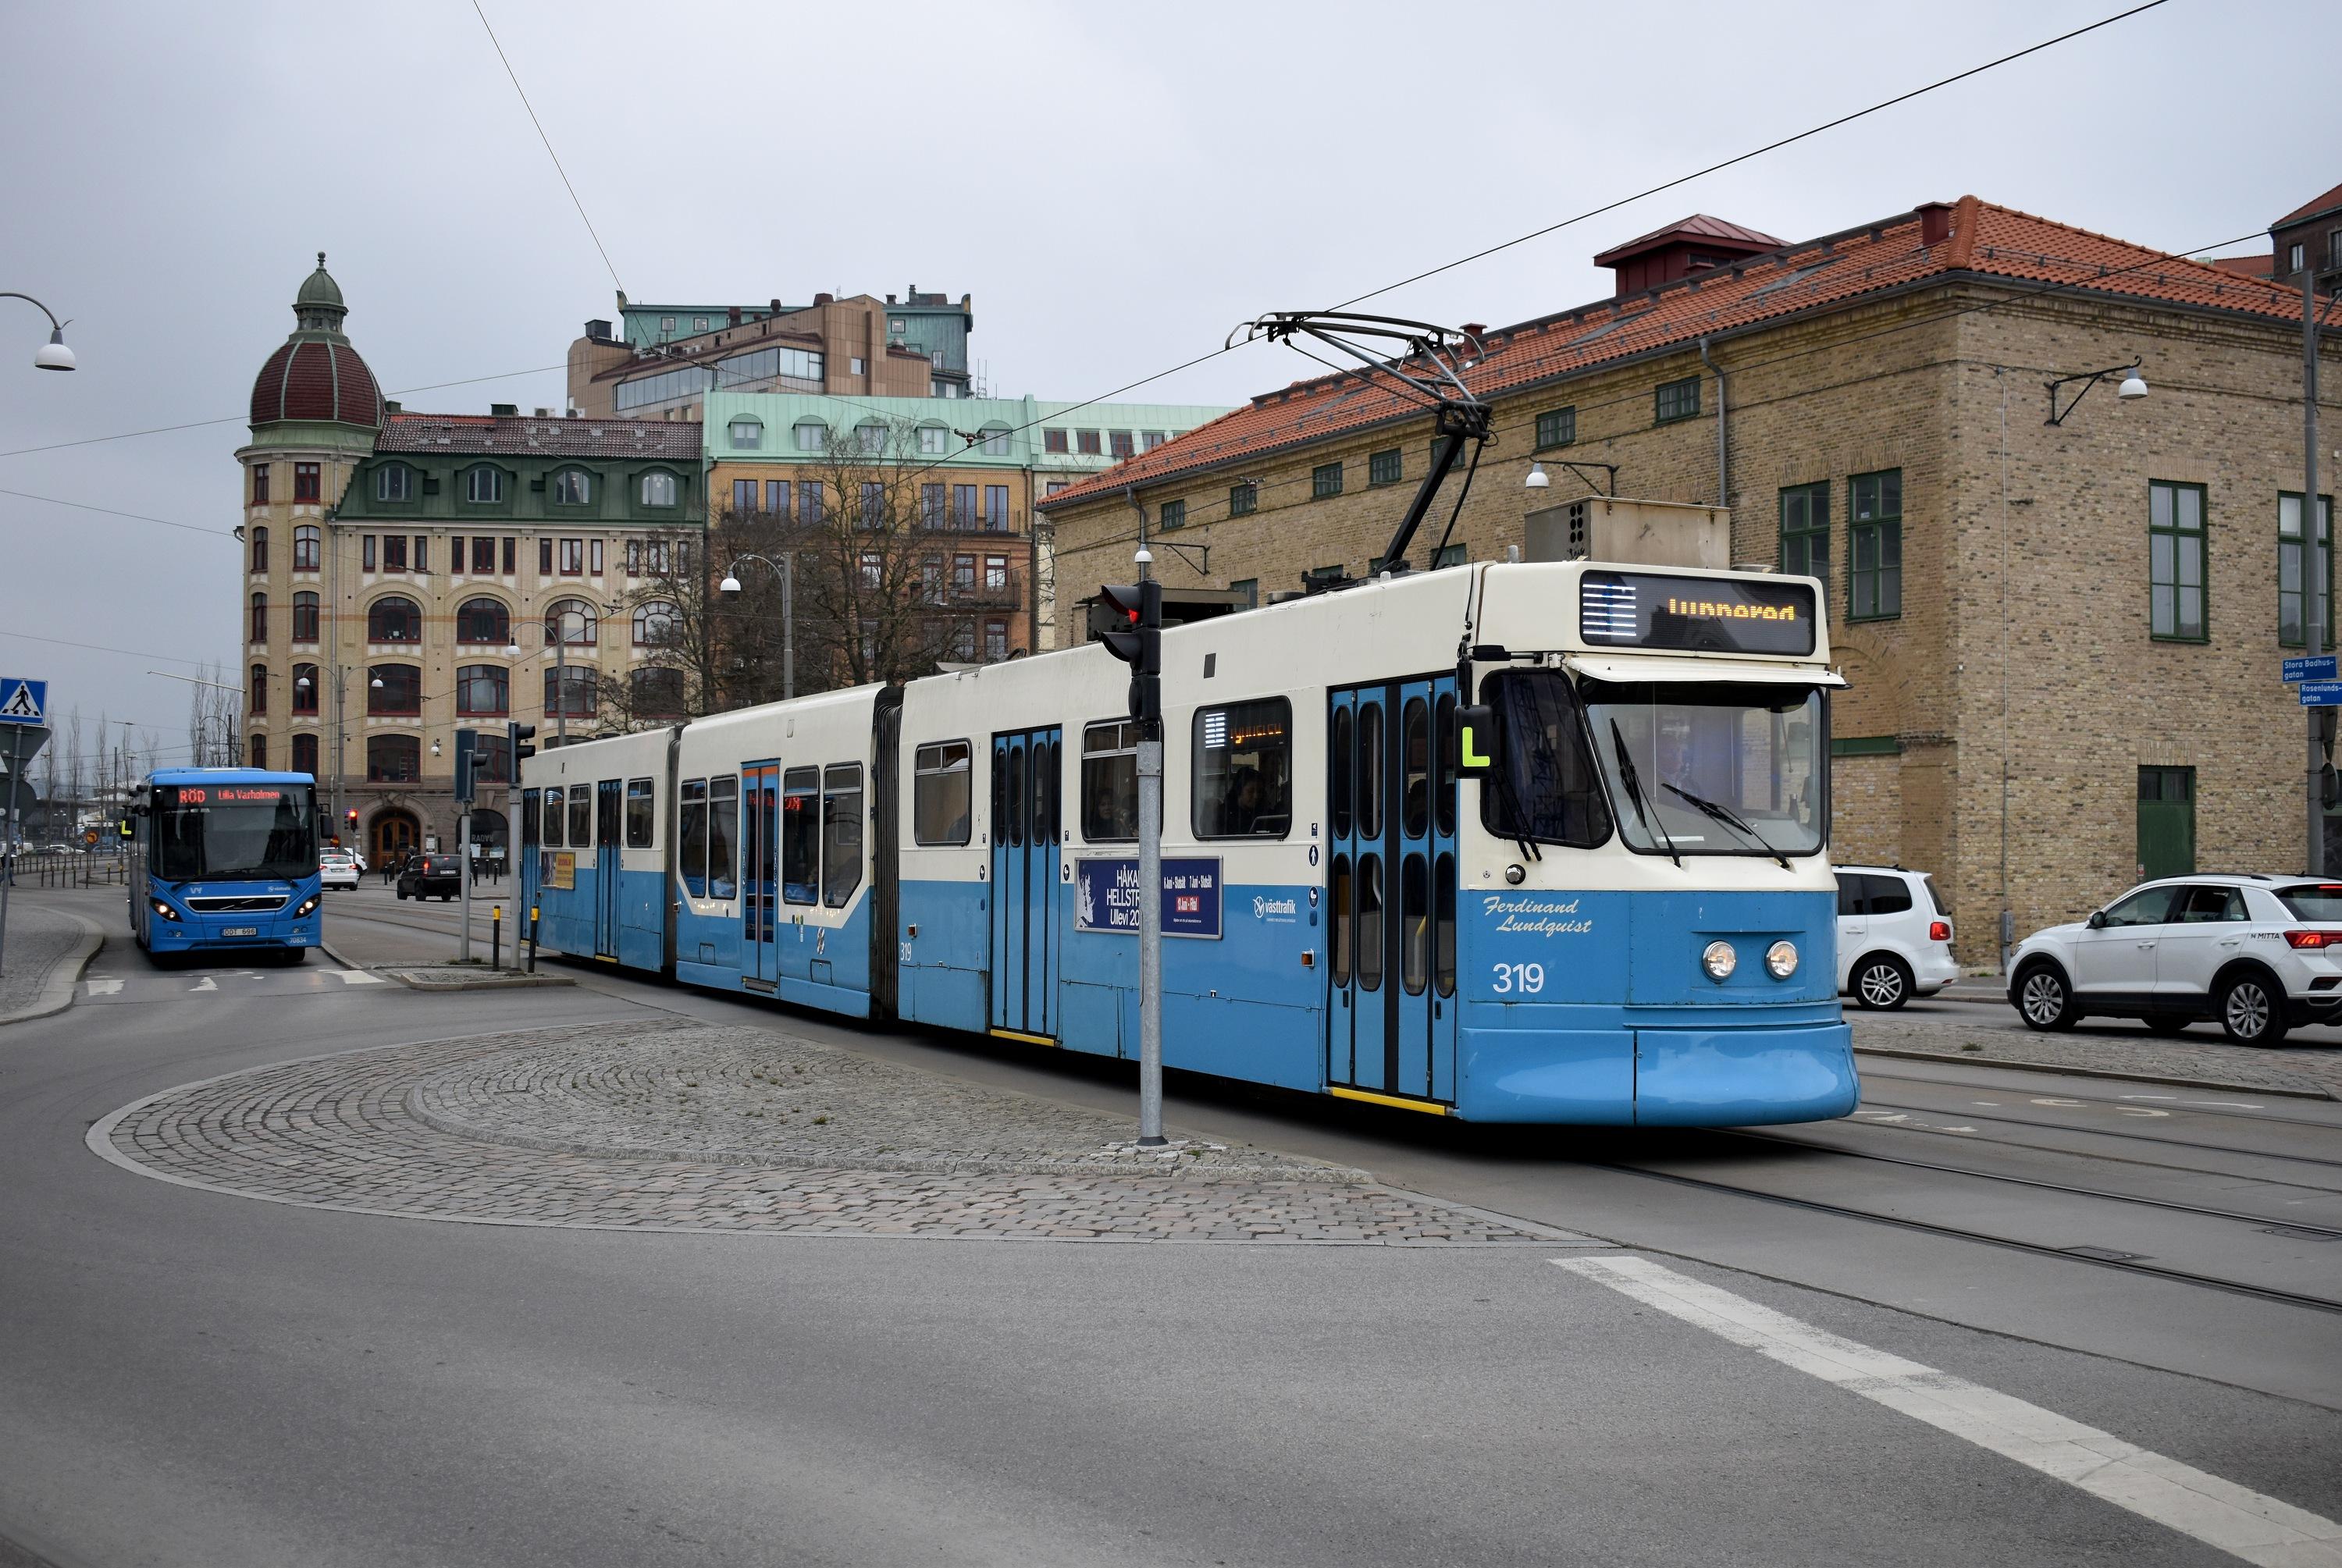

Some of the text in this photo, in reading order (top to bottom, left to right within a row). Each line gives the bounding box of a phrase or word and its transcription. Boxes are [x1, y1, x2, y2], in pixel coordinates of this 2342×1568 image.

[2284, 671, 2304, 680] gatan
[2302, 695, 2321, 704] gatan
[179, 788, 280, 803] RÖD Lilla Varholmen
[1116, 864, 1139, 887] HÅKA
[1265, 899, 1296, 914] västtrafik
[1483, 896, 1579, 916] Ferdinand
[1110, 908, 1128, 926] Ullevi
[1496, 915, 1592, 937] Lundquist
[900, 942, 912, 961] 319
[1493, 963, 1544, 993] 319
